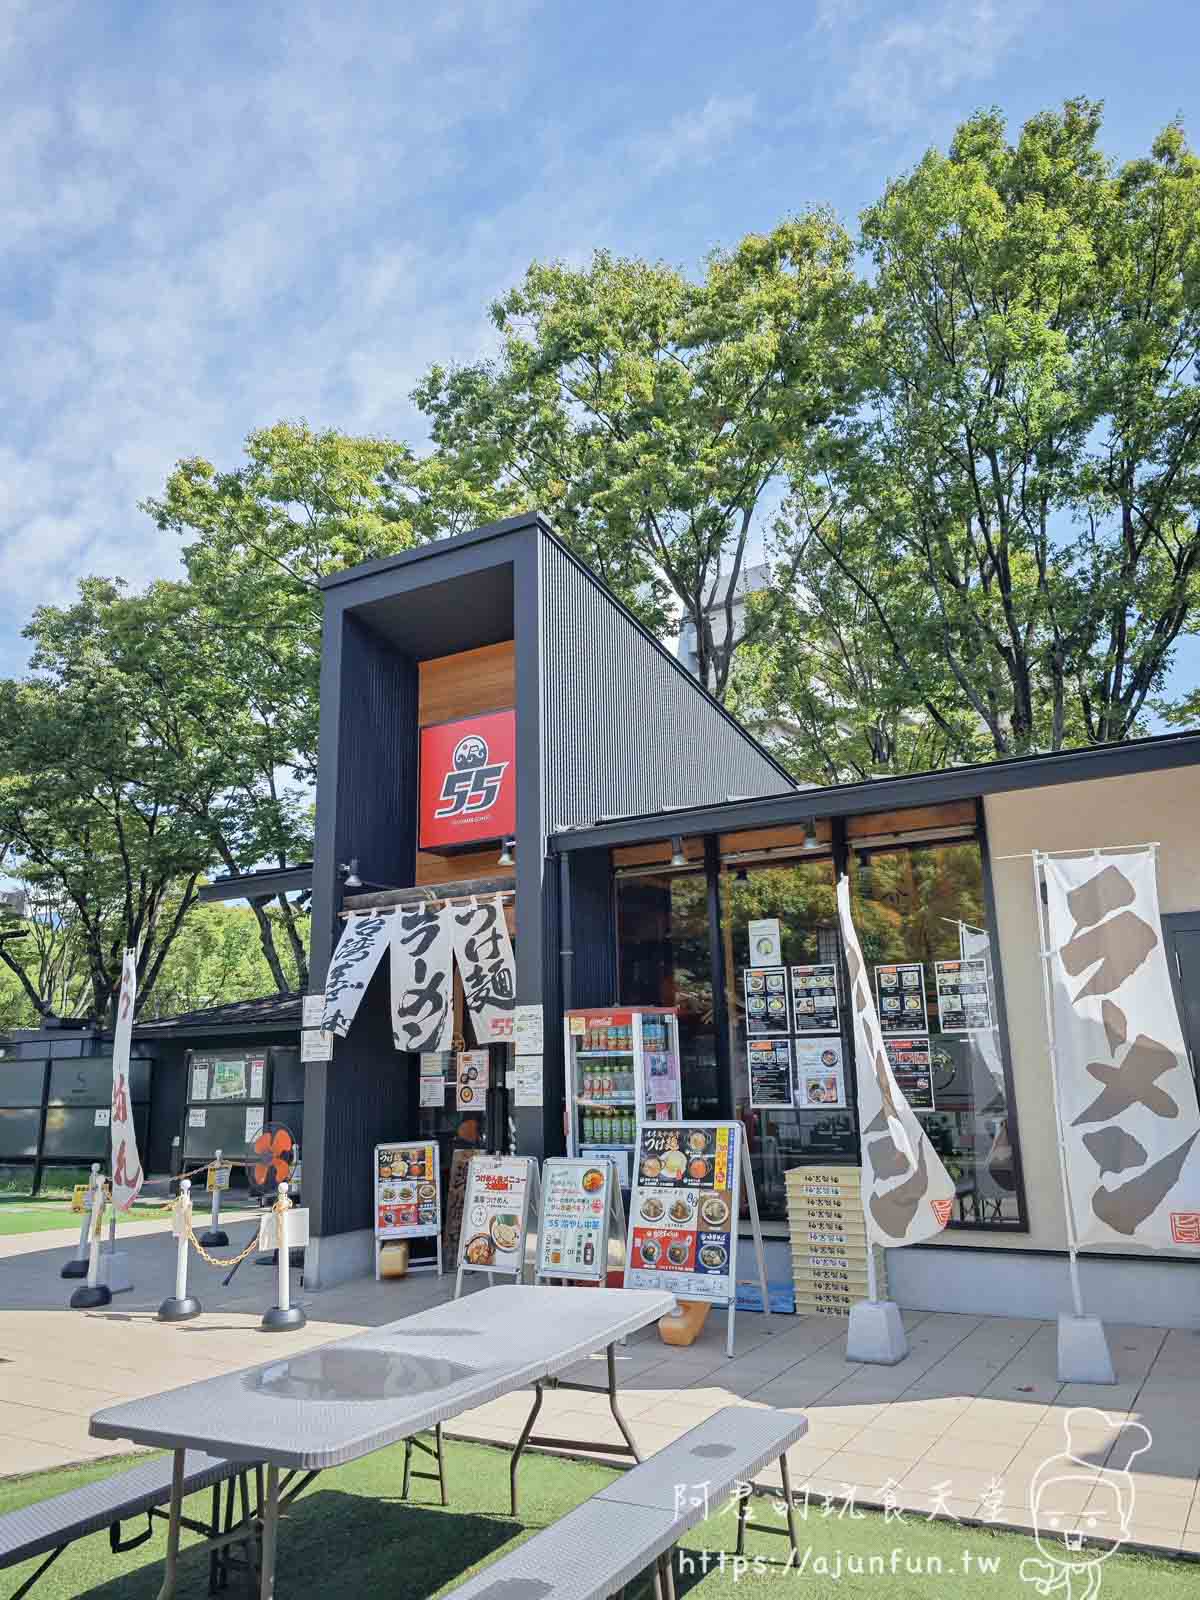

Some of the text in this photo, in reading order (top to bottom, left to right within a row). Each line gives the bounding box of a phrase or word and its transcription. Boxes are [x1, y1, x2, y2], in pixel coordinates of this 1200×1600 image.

[433, 761, 510, 819] 55
[393, 911, 449, 1051] ラーメン
[1058, 864, 1199, 1236] ラーメン
